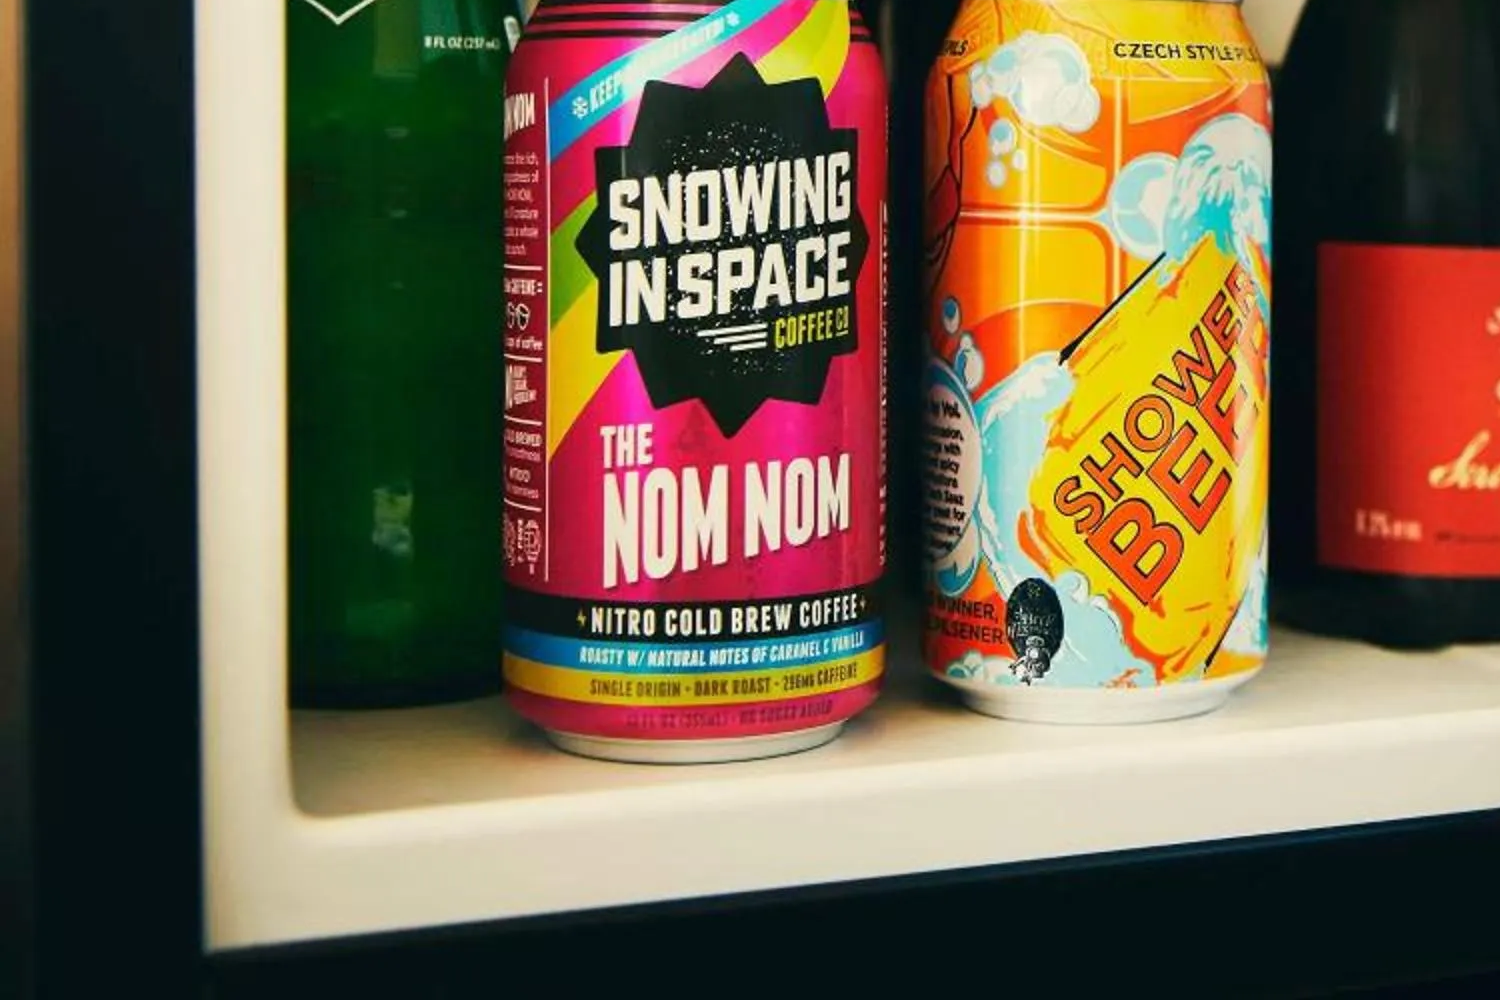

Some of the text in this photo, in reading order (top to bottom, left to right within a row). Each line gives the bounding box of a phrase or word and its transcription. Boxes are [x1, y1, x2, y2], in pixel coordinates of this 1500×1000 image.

[1113, 42, 1181, 59] CZECH
[609, 151, 851, 251] SNOWING
[608, 231, 851, 328] IN SPACE
[774, 308, 833, 349] COFFEE
[1053, 262, 1257, 535] SHOWER
[600, 423, 653, 469] THE
[603, 453, 851, 590] NOM NOM
[591, 593, 858, 637] NITRO COLD BREW COFFEE
[579, 645, 625, 665] ROASTY
[627, 648, 646, 667] W/
[647, 649, 707, 668] NATURAL
[709, 647, 750, 667] NOTES
[751, 645, 769, 665] OF
[769, 641, 822, 662] CARAMEL
[589, 678, 633, 697] SINGLE
[636, 680, 681, 698] ORIGIN
[694, 679, 729, 698] DARK
[731, 677, 770, 696] ROAST
